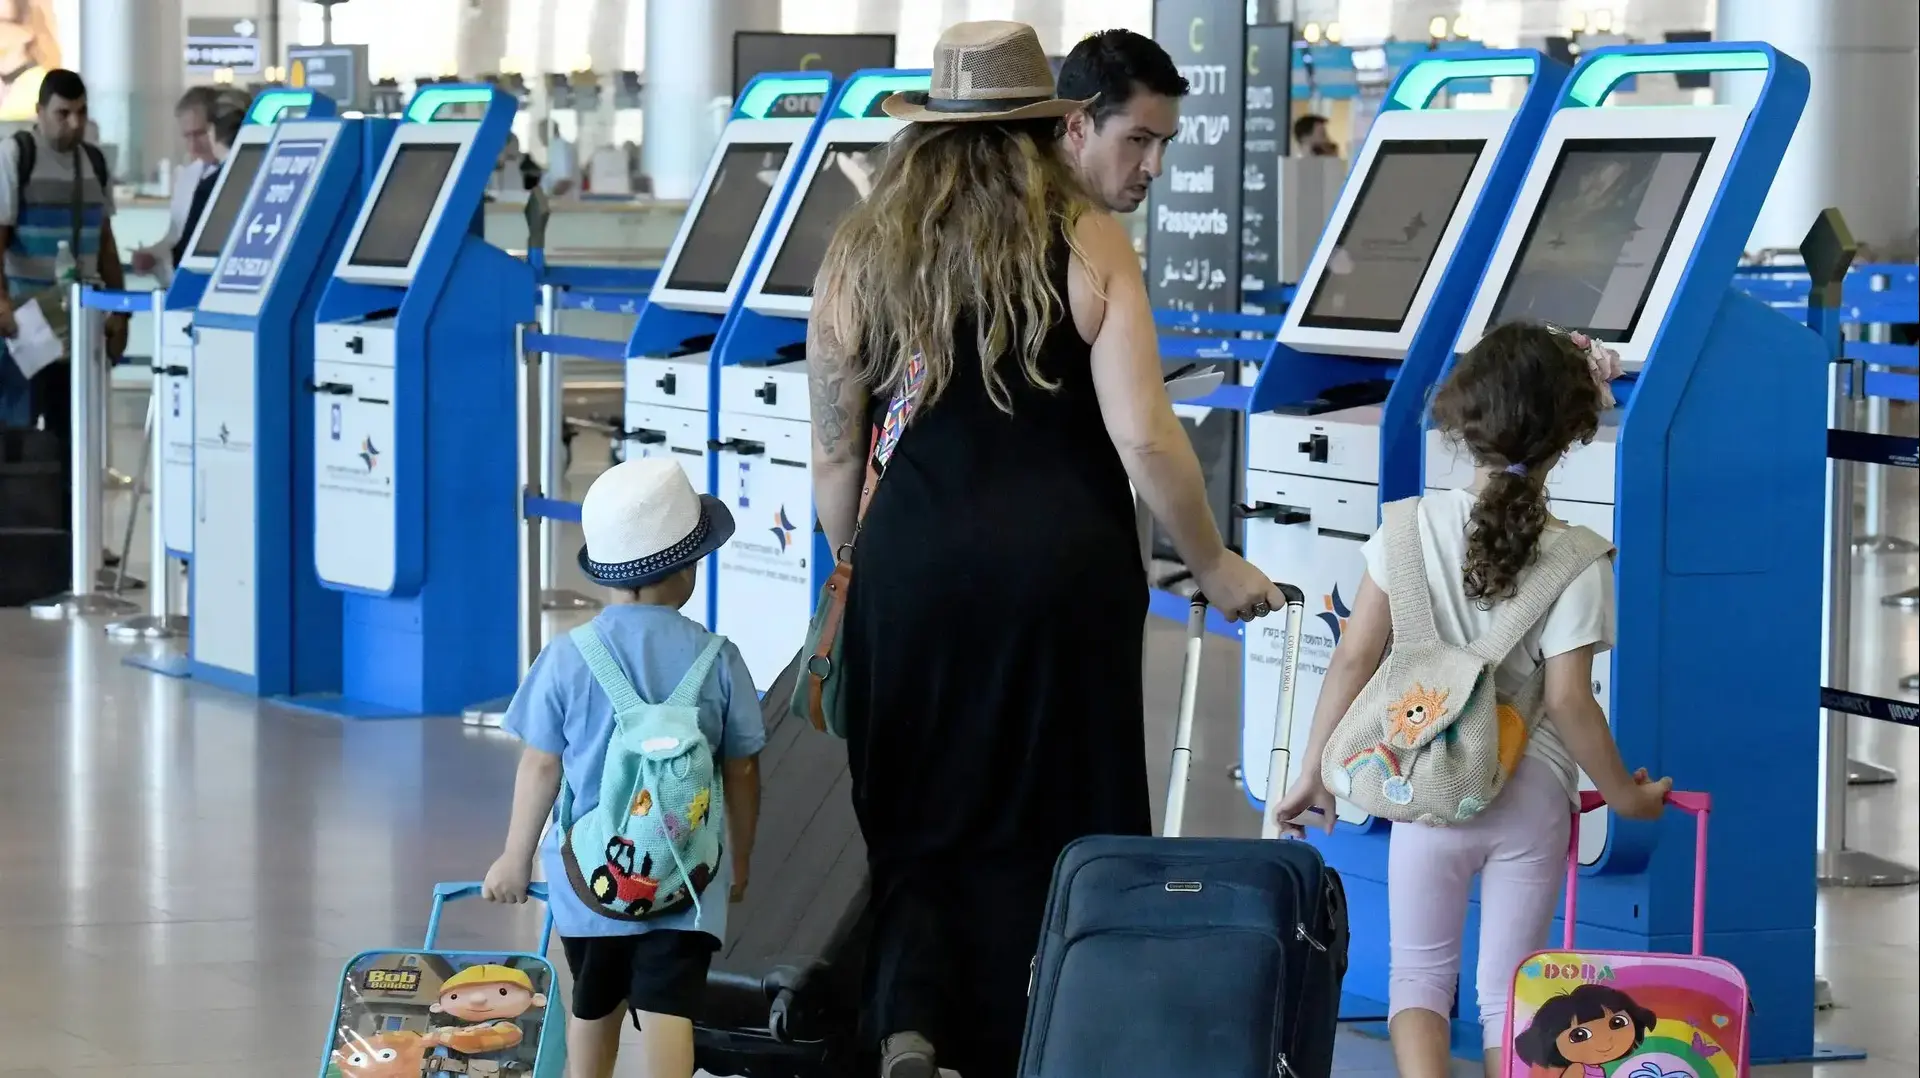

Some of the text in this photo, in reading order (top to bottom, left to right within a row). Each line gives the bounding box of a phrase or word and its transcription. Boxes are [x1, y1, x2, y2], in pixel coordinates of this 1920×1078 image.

[1189, 17, 1205, 53] C
[1178, 115, 1230, 146] ישראל
[1170, 164, 1215, 193] Israeli
[1157, 204, 1228, 240] Passports
[368, 970, 417, 984] Bob
[370, 981, 416, 990] Builder
[1544, 963, 1615, 981] DORA
